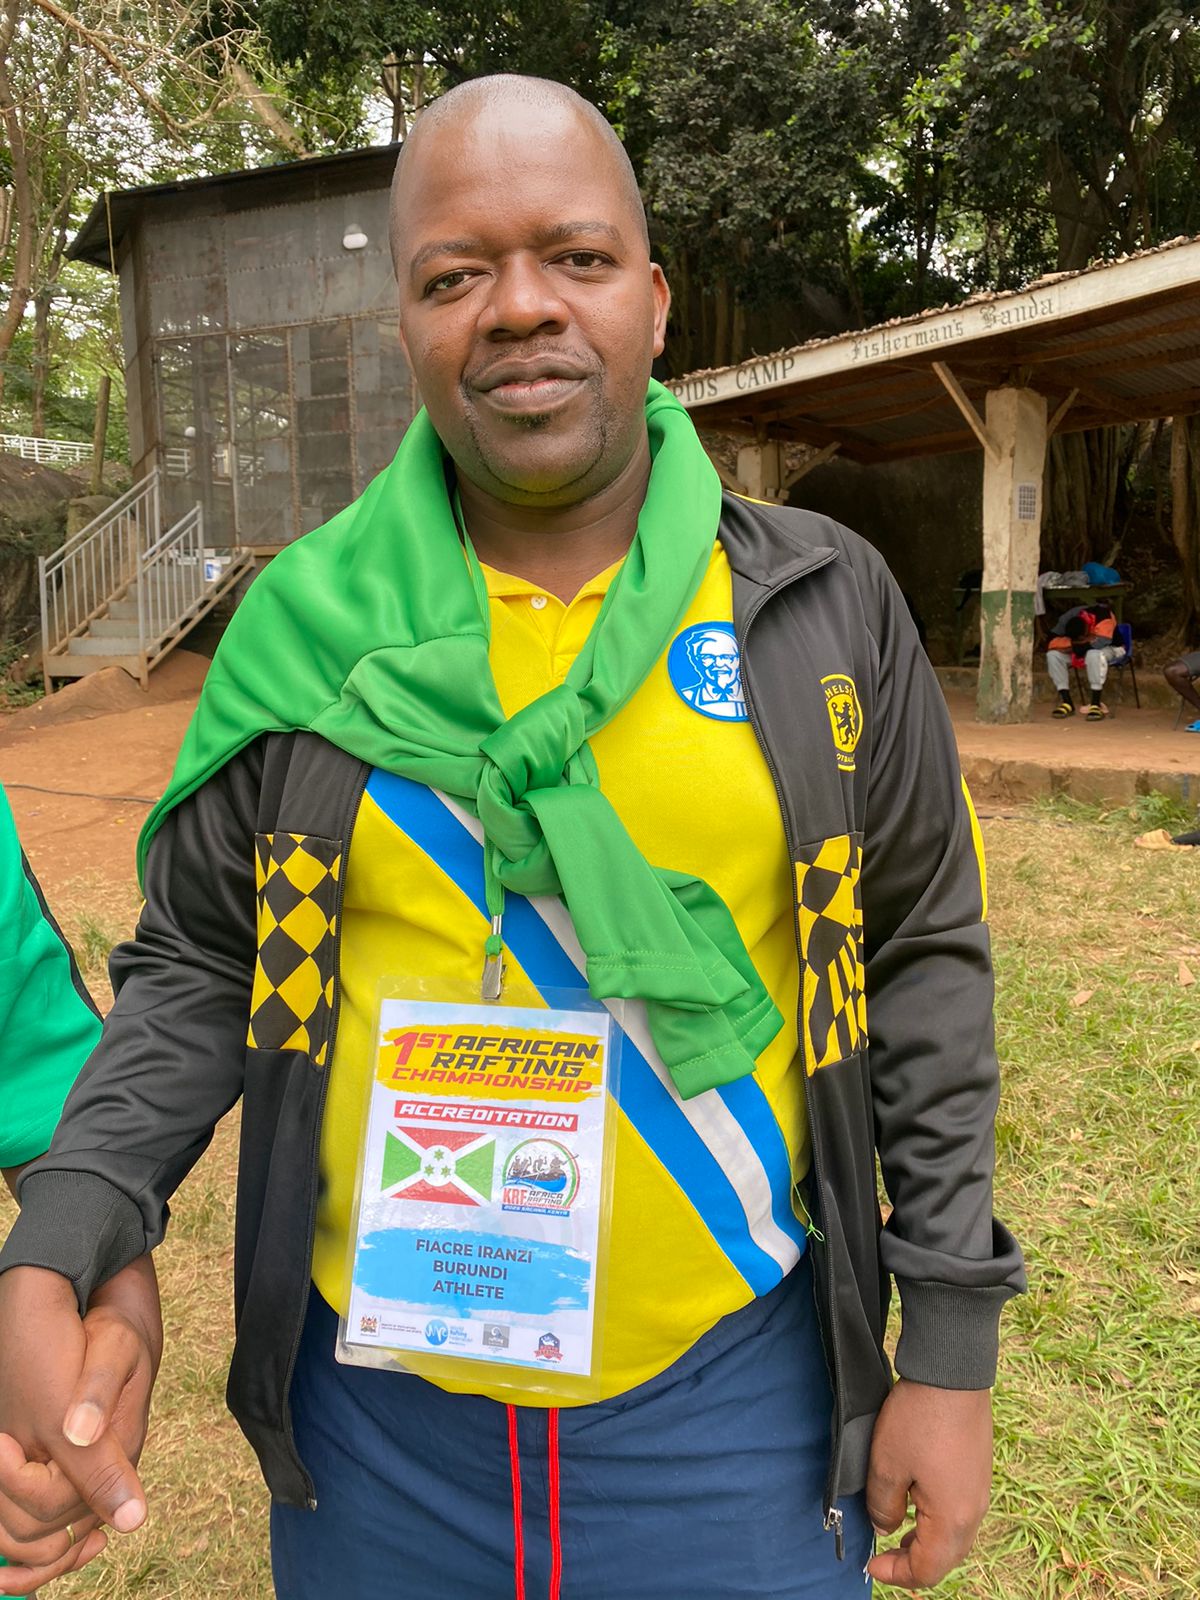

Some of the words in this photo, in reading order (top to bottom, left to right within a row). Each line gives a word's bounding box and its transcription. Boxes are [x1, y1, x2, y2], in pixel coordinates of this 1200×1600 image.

[851, 318, 964, 361] Fisherman's
[980, 296, 1054, 330] Banda
[671, 377, 719, 402] PIDS
[736, 356, 795, 390] CAMP
[393, 1031, 453, 1066] 1ST
[452, 1034, 600, 1060] AFRICAN
[430, 1051, 585, 1078] RAFTING
[391, 1067, 593, 1093] CHAMPIONSHIP
[399, 1103, 575, 1128] ACCREDITATION
[526, 1196, 563, 1206] RAFTING
[528, 1190, 564, 1200] AFRICA
[416, 1238, 473, 1257] FIACRE
[477, 1245, 532, 1263] IRANZI
[433, 1260, 508, 1280] BURUNDI
[432, 1279, 504, 1300] ATHLETE
